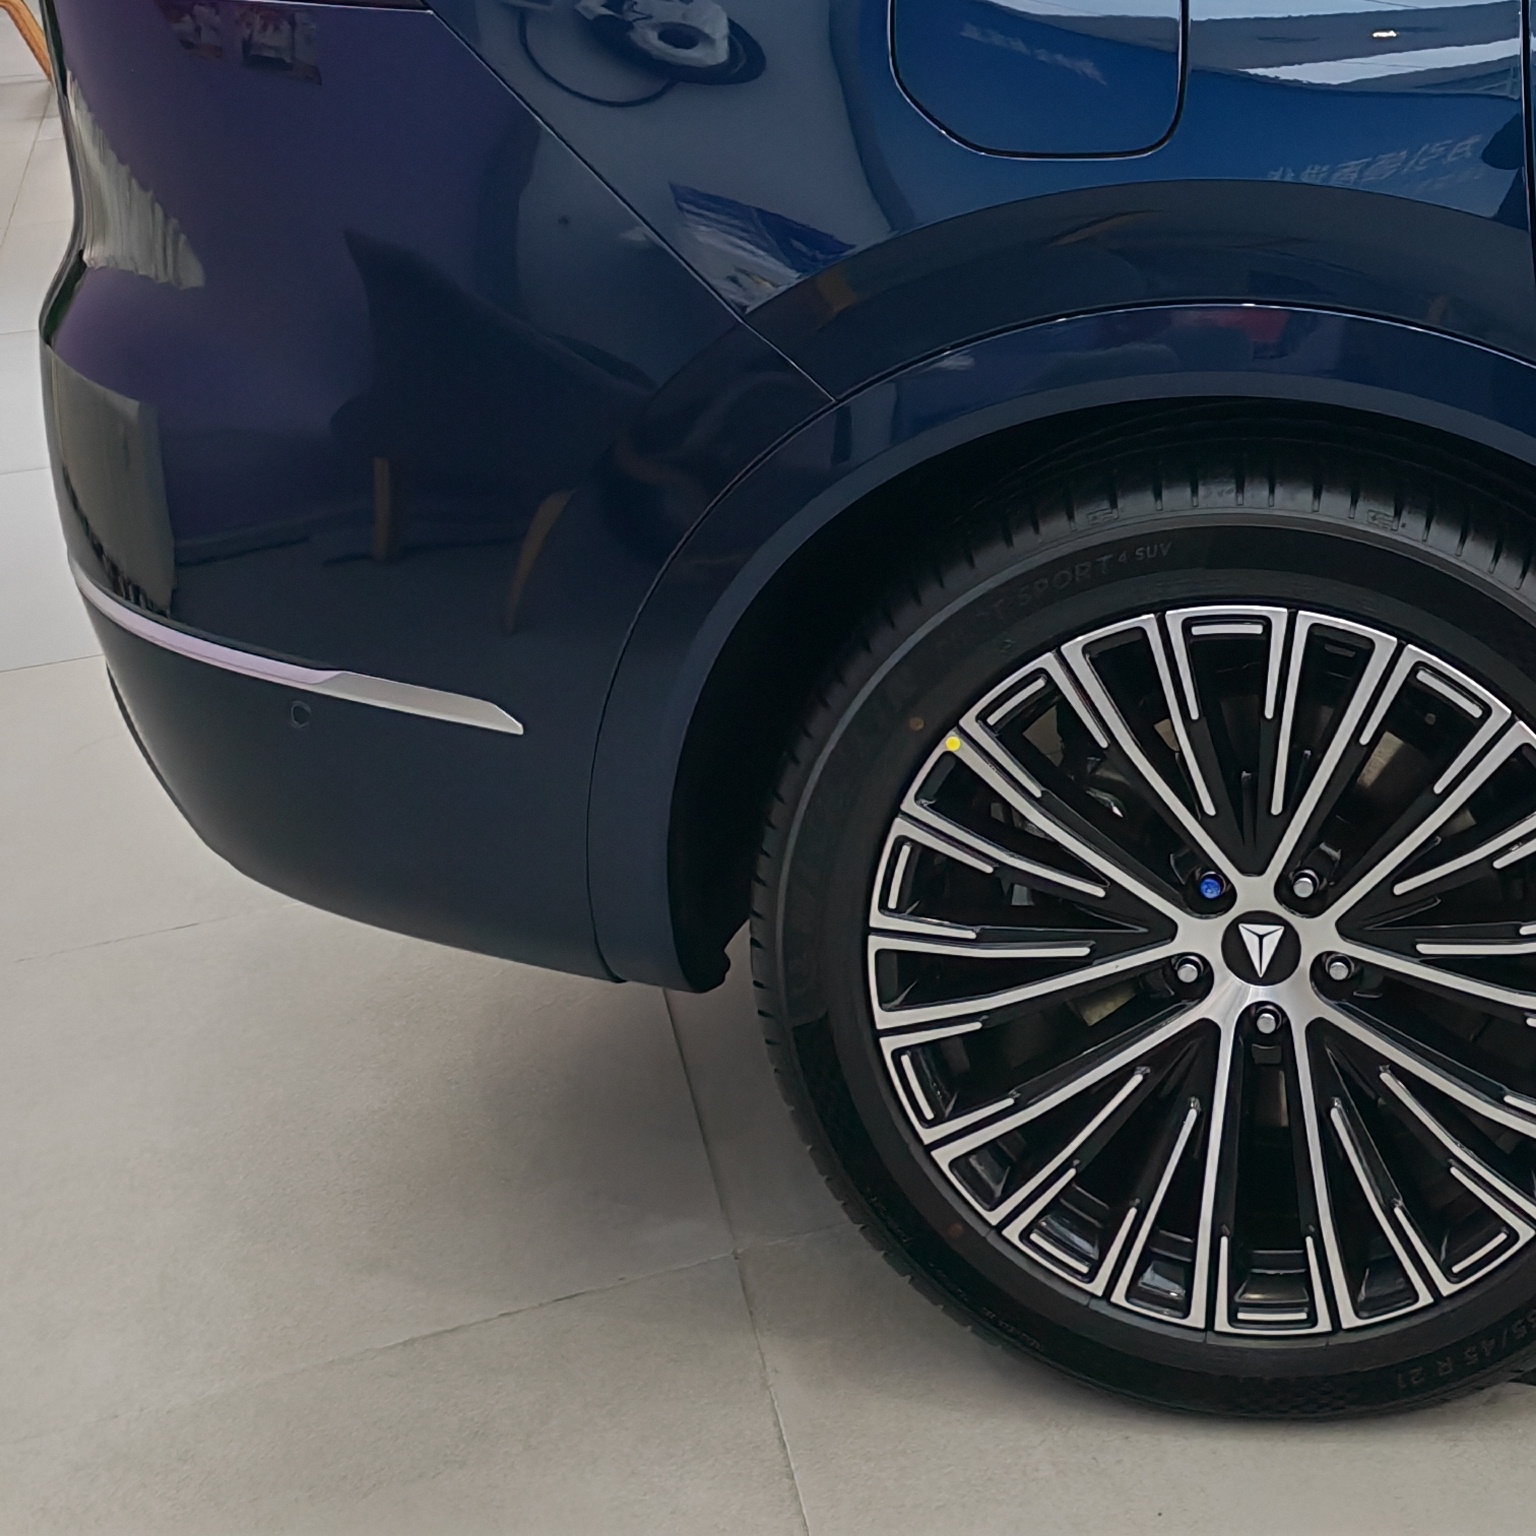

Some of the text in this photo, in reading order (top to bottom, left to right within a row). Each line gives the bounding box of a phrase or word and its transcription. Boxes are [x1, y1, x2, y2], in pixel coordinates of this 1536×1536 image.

[1018, 554, 1113, 607] SPORT
[1135, 541, 1173, 561] SUV
[1437, 1357, 1453, 1375] R
[1397, 1368, 1424, 1388] 21
